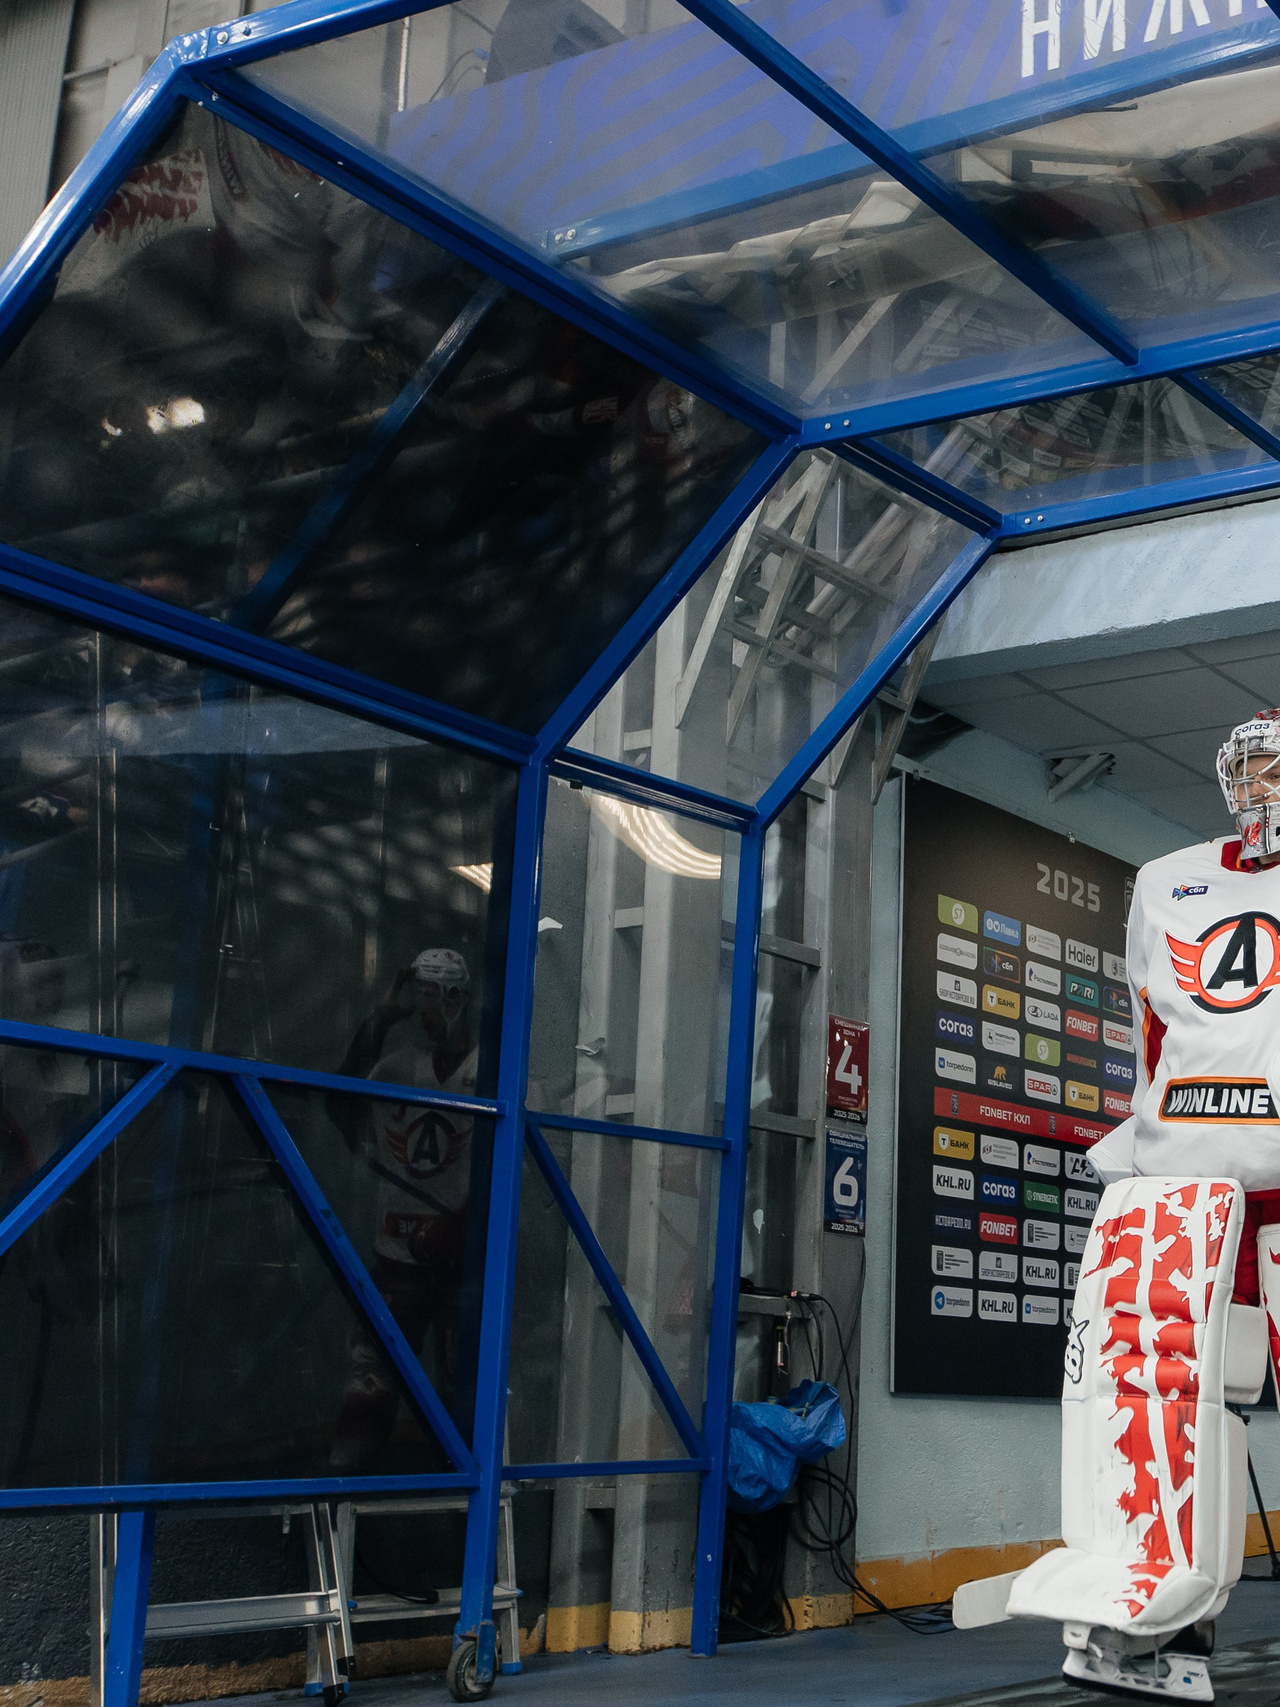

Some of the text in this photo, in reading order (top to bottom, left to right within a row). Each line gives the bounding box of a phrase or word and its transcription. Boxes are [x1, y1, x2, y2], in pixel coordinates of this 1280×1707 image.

[1234, 722, 1271, 736] согаз
[1036, 862, 1100, 913] 2025
[1188, 886, 1205, 894] сбп
[1000, 923, 1019, 939] Лавка
[1068, 944, 1096, 968] Haier
[1001, 962, 1014, 972] сбп
[1070, 982, 1095, 1000] PARI
[997, 998, 1016, 1009] БАНК
[1043, 1011, 1059, 1021] LADA
[939, 1018, 974, 1038] согаз
[1066, 1016, 1098, 1035] FONBET
[1105, 1029, 1126, 1042] SPAR
[835, 1045, 862, 1095] 4
[946, 1061, 974, 1073] torpedonn
[1105, 1062, 1133, 1080] согаз
[1028, 1080, 1051, 1093] SPAR
[1078, 1092, 1095, 1102] БАНК
[1168, 1088, 1271, 1114] WINLINE
[980, 1105, 1031, 1125] FONBET КХЛ
[1074, 1126, 1102, 1140] FONBET
[950, 1139, 970, 1150] БАНК
[833, 1156, 859, 1207] 6
[936, 1174, 971, 1191] KHL.RU
[982, 1181, 1016, 1199] согаз
[1067, 1196, 1097, 1212] KHL.RU
[980, 1220, 1017, 1237] FONBET
[1025, 1265, 1057, 1280] KHL.RU
[981, 1299, 1014, 1314] KHL.RU
